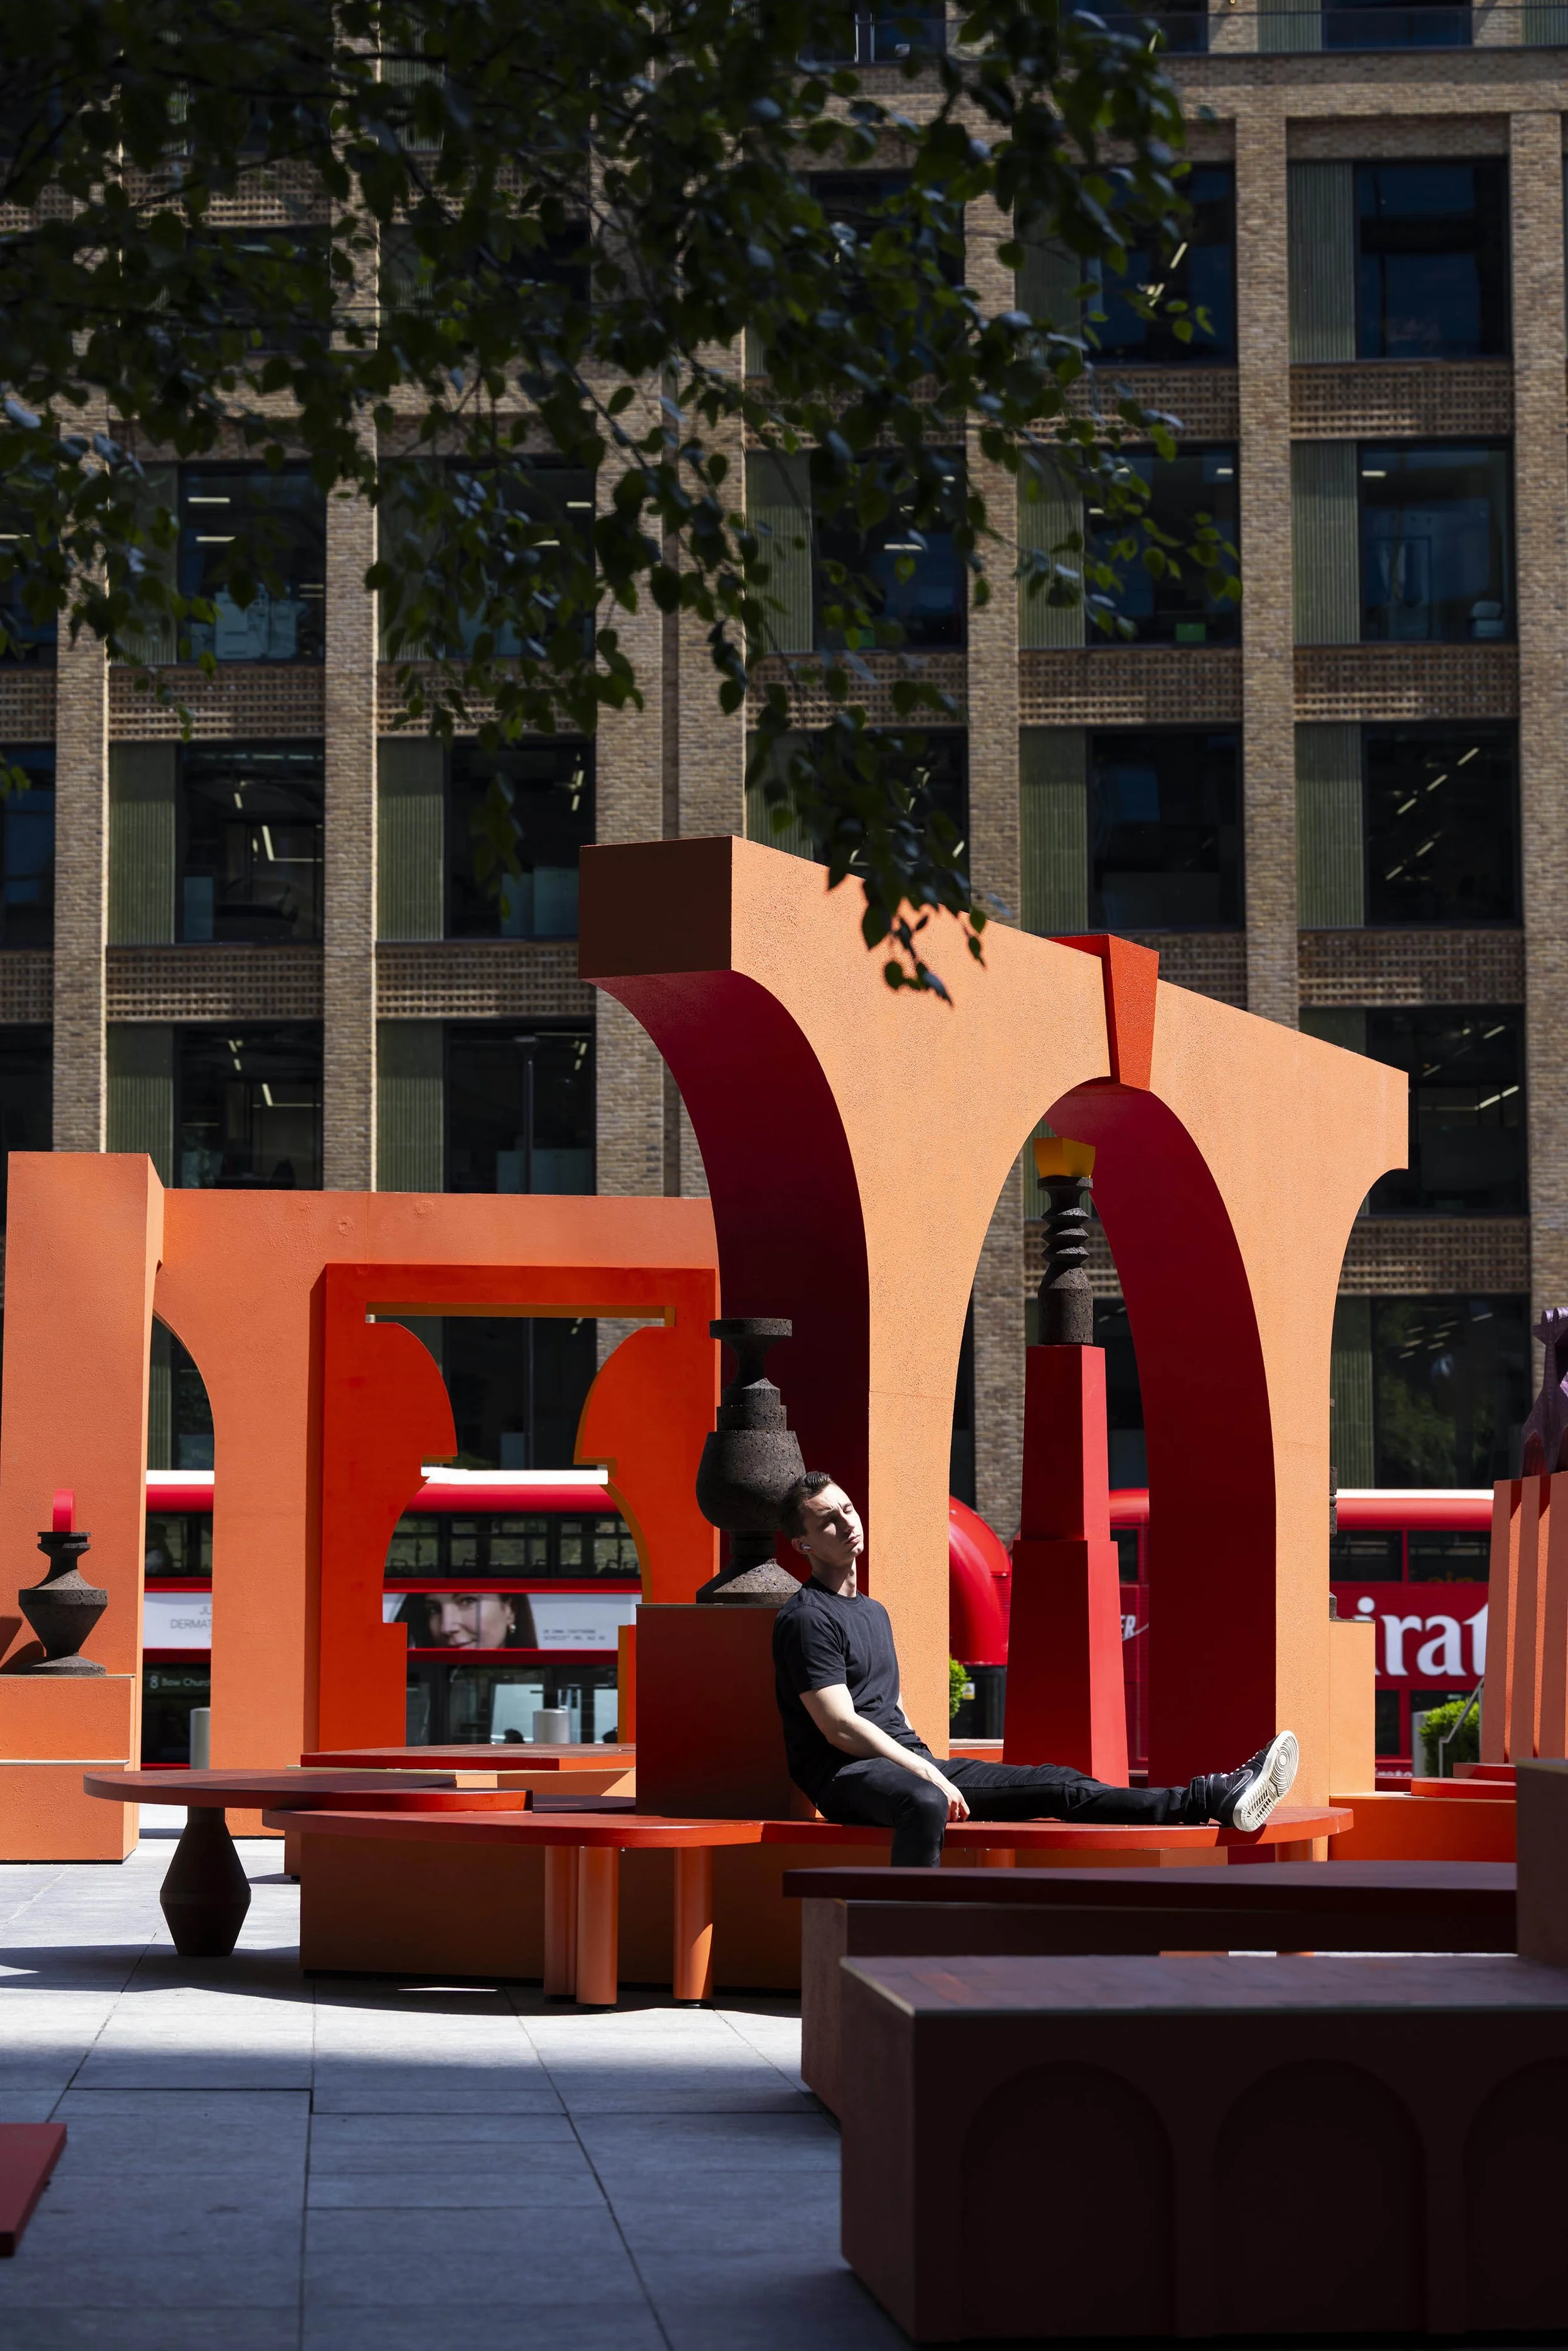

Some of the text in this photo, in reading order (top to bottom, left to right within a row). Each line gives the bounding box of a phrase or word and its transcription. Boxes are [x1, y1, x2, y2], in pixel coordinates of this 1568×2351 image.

[1353, 1596, 1488, 1677] rat
[149, 1675, 159, 1689] 8
[161, 1677, 181, 1687] Bow
